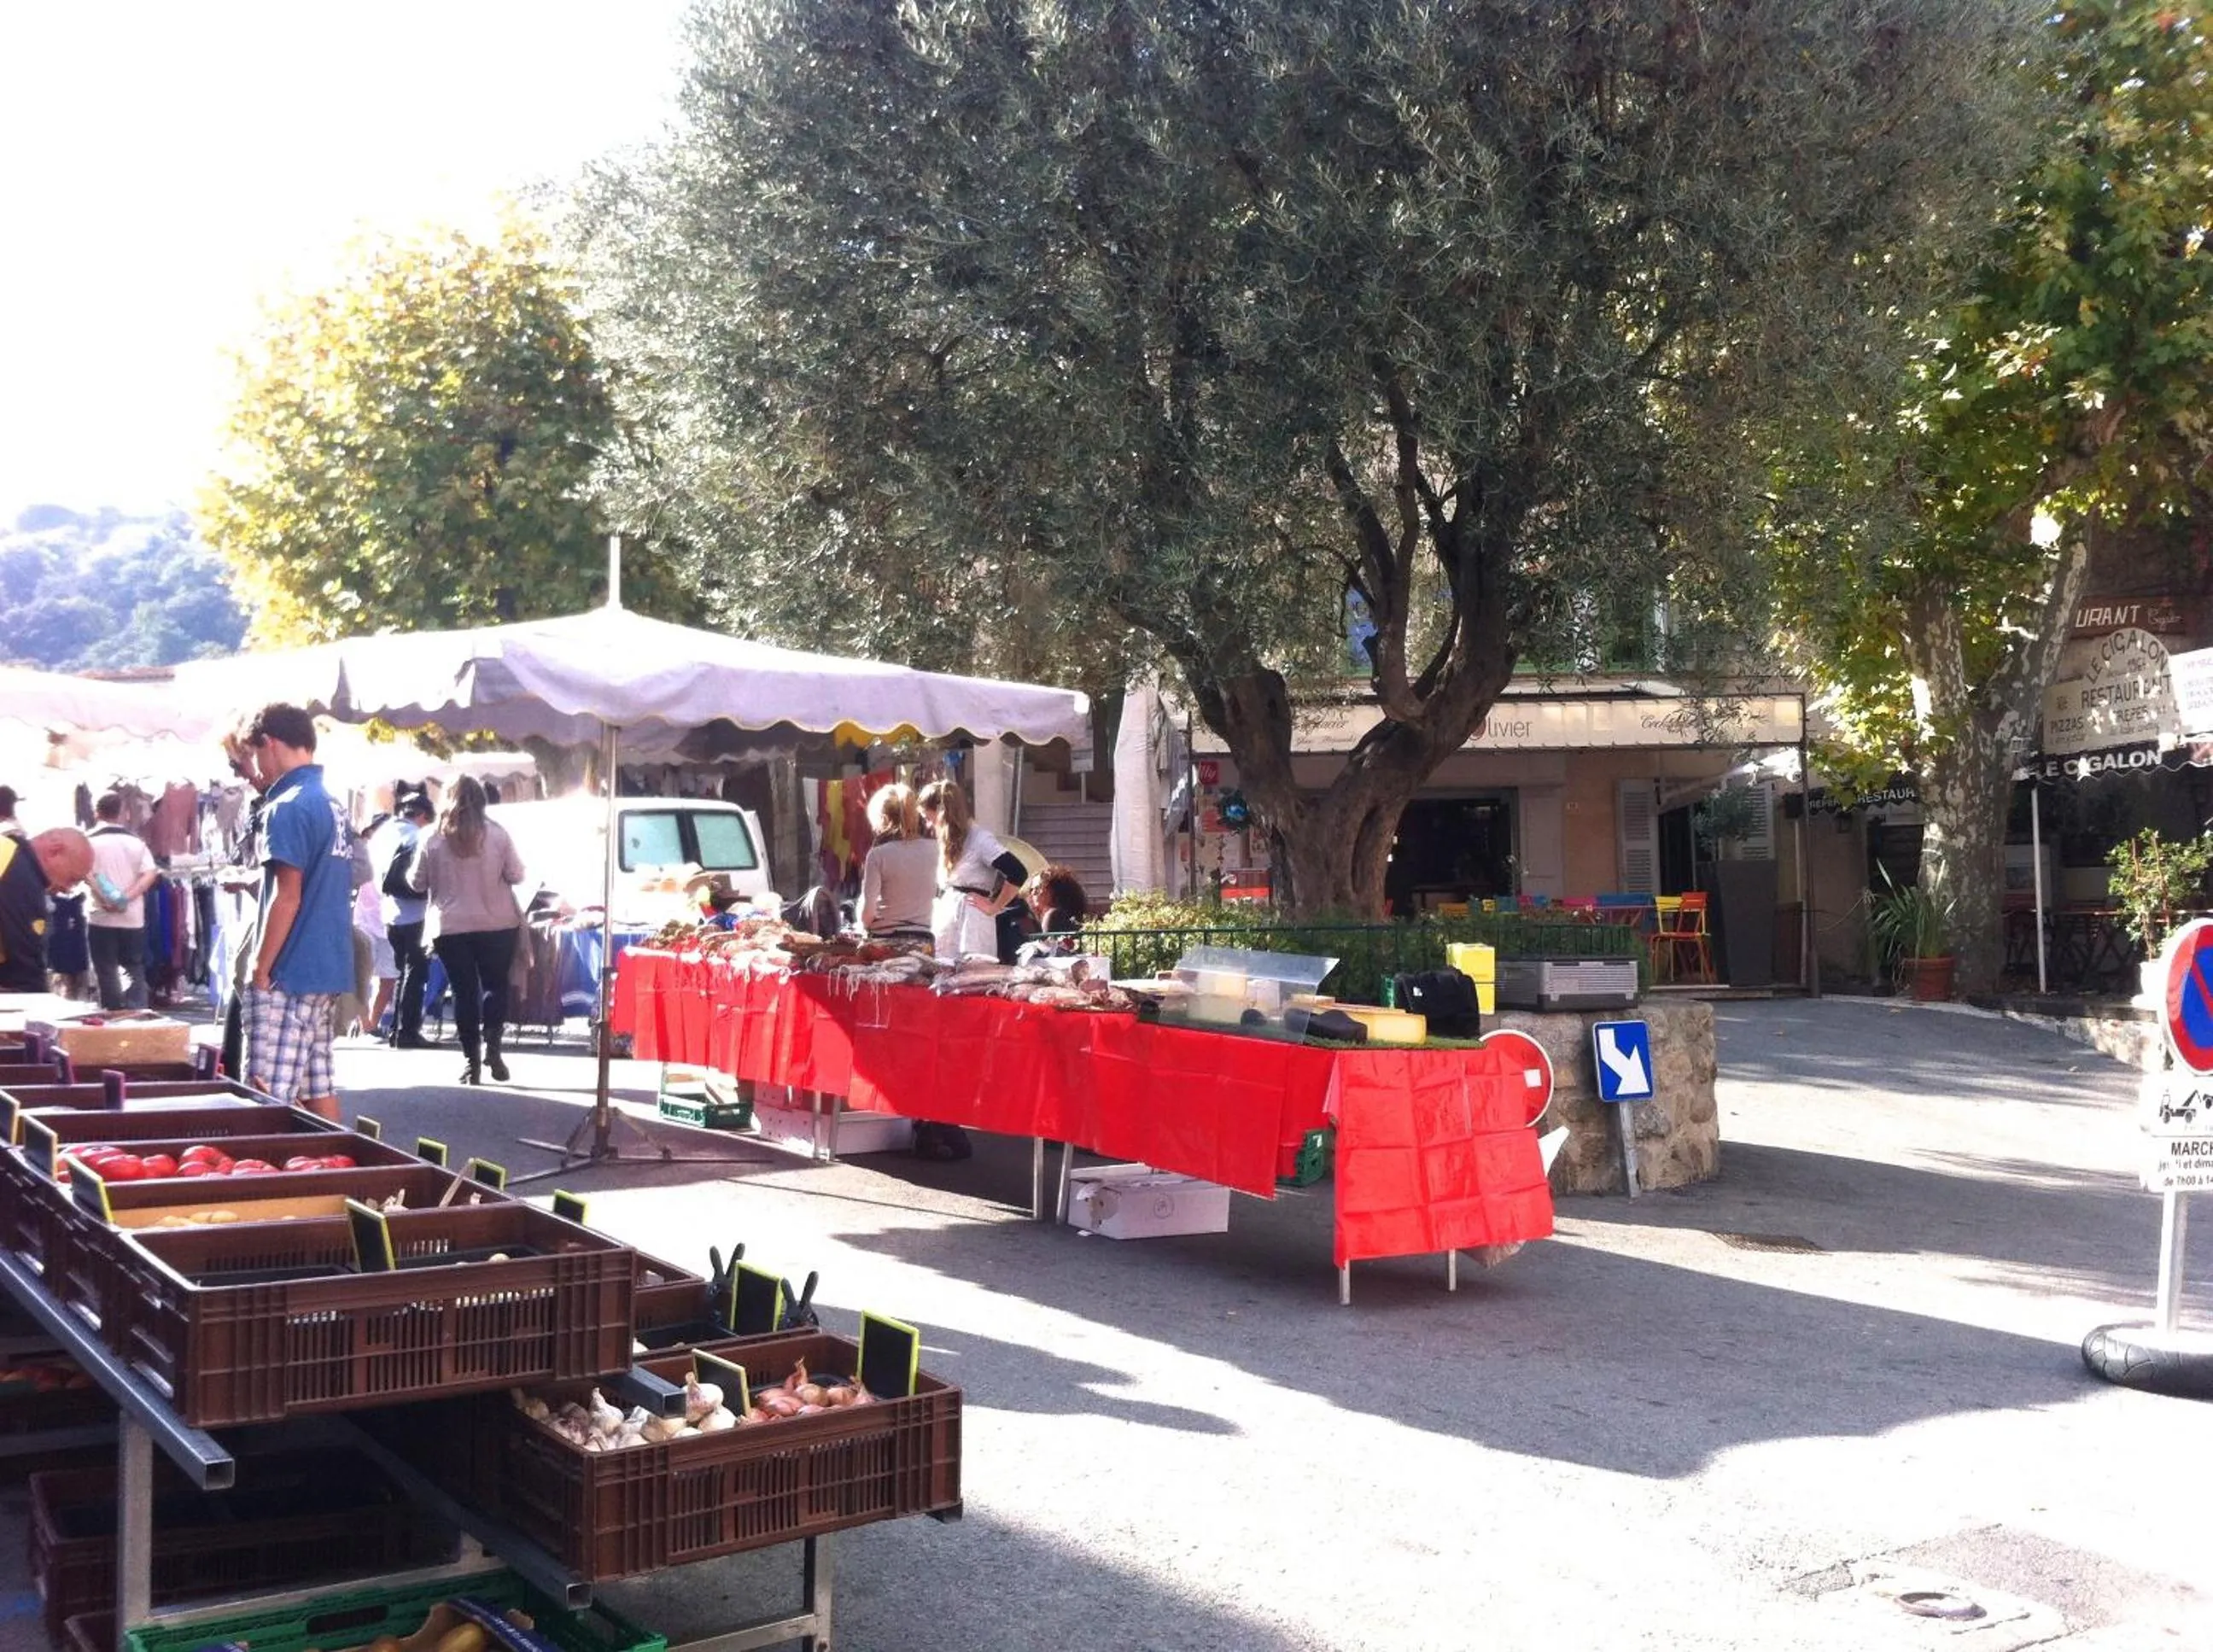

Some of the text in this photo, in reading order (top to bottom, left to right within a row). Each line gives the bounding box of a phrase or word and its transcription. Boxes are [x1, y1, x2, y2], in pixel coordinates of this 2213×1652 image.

[2087, 657, 2103, 684] LE
[2100, 630, 2169, 671] CIGALON
[2064, 750, 2162, 775] CGALON
